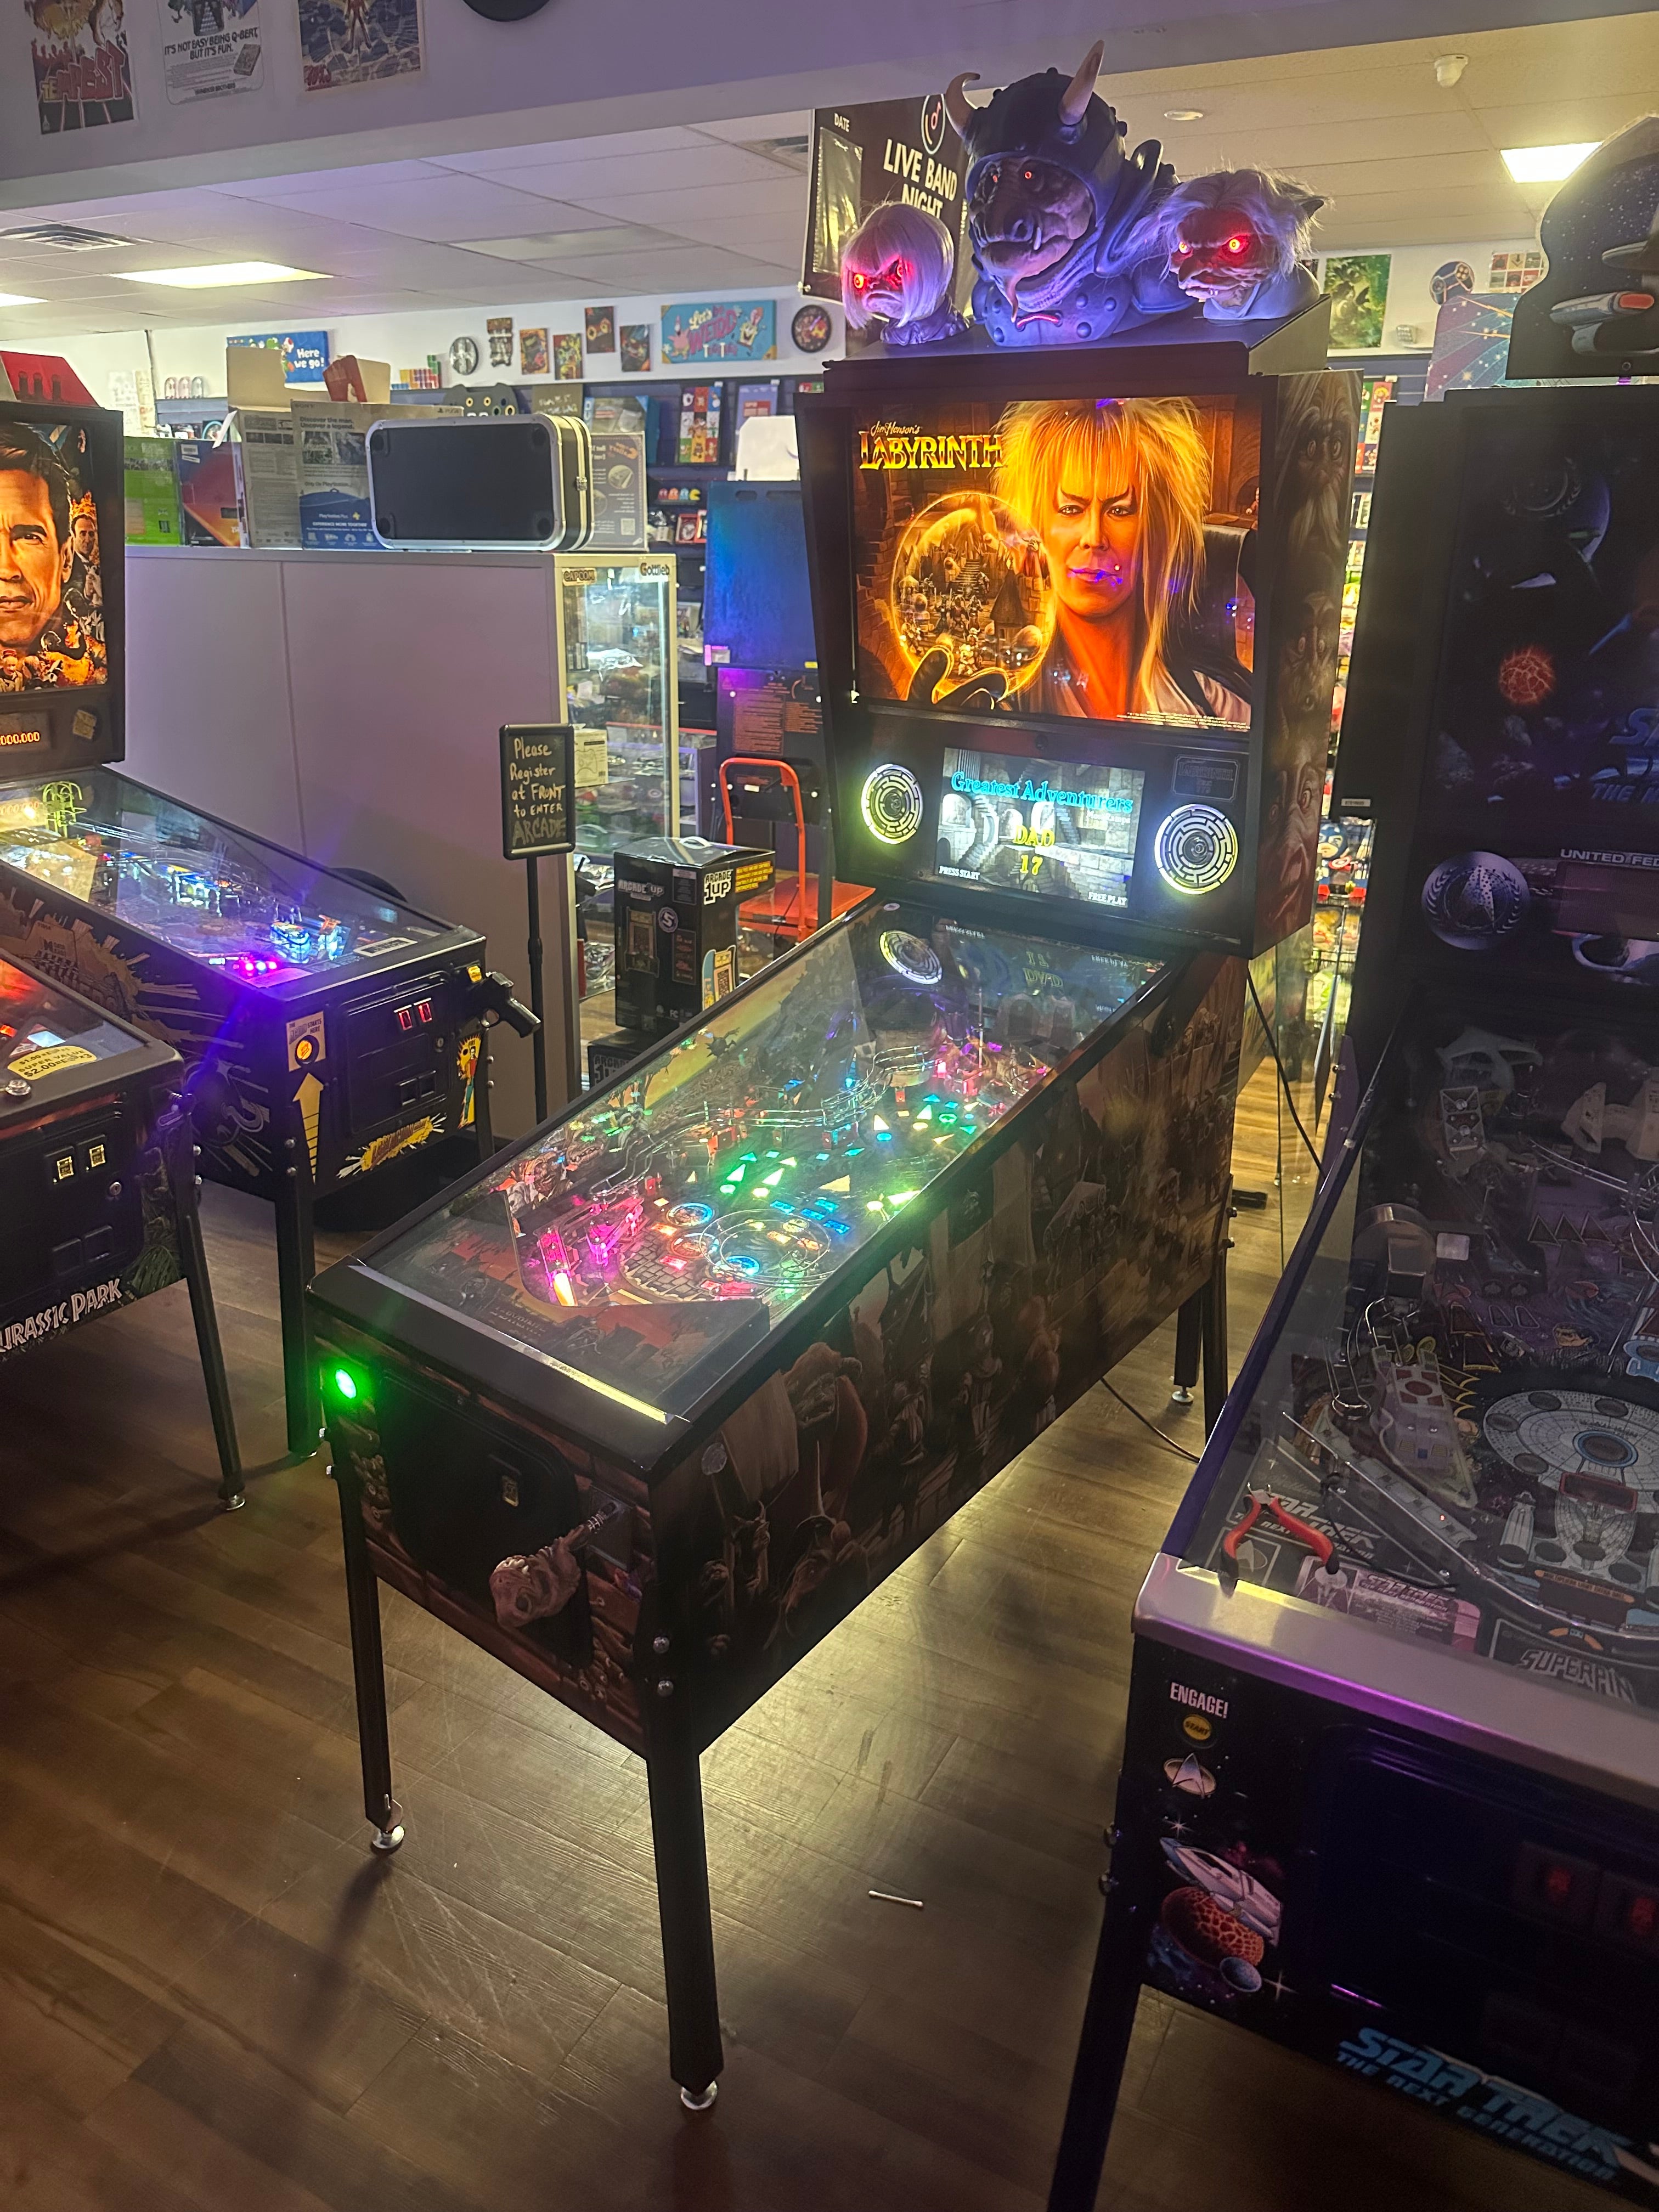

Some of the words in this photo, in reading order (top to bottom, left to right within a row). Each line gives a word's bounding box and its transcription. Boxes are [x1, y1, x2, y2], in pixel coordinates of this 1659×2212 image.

[165, 45, 176, 55] IT'S
[178, 41, 191, 52] NOT
[193, 37, 208, 49] EASY
[210, 33, 230, 45] BEING
[190, 48, 204, 59] BUT
[205, 46, 216, 57] IT'S
[218, 43, 233, 54] FUN.
[40, 40, 126, 103] TEMPEST
[834, 113, 850, 132] DATE
[883, 139, 923, 183] LIVE
[925, 157, 958, 201] BAND
[901, 184, 944, 219] NIGHT
[297, 348, 319, 358] Here
[308, 357, 324, 369] go!
[870, 420, 887, 436] Jim
[859, 431, 1004, 471] LABYRINTH
[563, 569, 595, 582] CAPCOM
[640, 562, 670, 576] Gottlieb
[514, 736, 552, 759] Please
[510, 763, 556, 785] Register
[512, 784, 526, 800] at
[531, 783, 566, 801] FRONT
[951, 771, 1021, 799] Greatest
[1021, 781, 1133, 814] Adventurers
[1592, 783, 1636, 802] THE
[514, 804, 526, 818] to
[530, 803, 563, 816] ENTER
[512, 817, 566, 847] ARCADE
[1012, 825, 1056, 848] DAD
[1020, 854, 1043, 876] 17
[1560, 849, 1626, 864] UNITED
[705, 871, 732, 884] ARCADE
[939, 866, 959, 877] PRESS
[960, 870, 980, 880] START
[618, 879, 647, 894] ARCADE
[704, 881, 730, 902] 1UP
[1088, 892, 1107, 902] FREE
[1107, 895, 1127, 905] PLAY
[307, 1018, 322, 1029] STARTS
[18, 1058, 52, 1073] SUPER
[54, 1050, 84, 1059] VALUE
[594, 1055, 628, 1069] ARCAD
[0, 1302, 69, 1353] URASSIC
[71, 1278, 123, 1322] PARK
[1518, 1649, 1637, 1704] SUPERPIN
[1170, 1682, 1228, 1719] ENGAGE!
[1185, 1721, 1210, 1735] START
[1339, 2027, 1481, 2097] STAR
[1483, 2080, 1634, 2168] TREK
[1336, 2051, 1380, 2076] THE
[1386, 2074, 1451, 2106] NEXT
[1457, 2105, 1616, 2181] GENERATION
